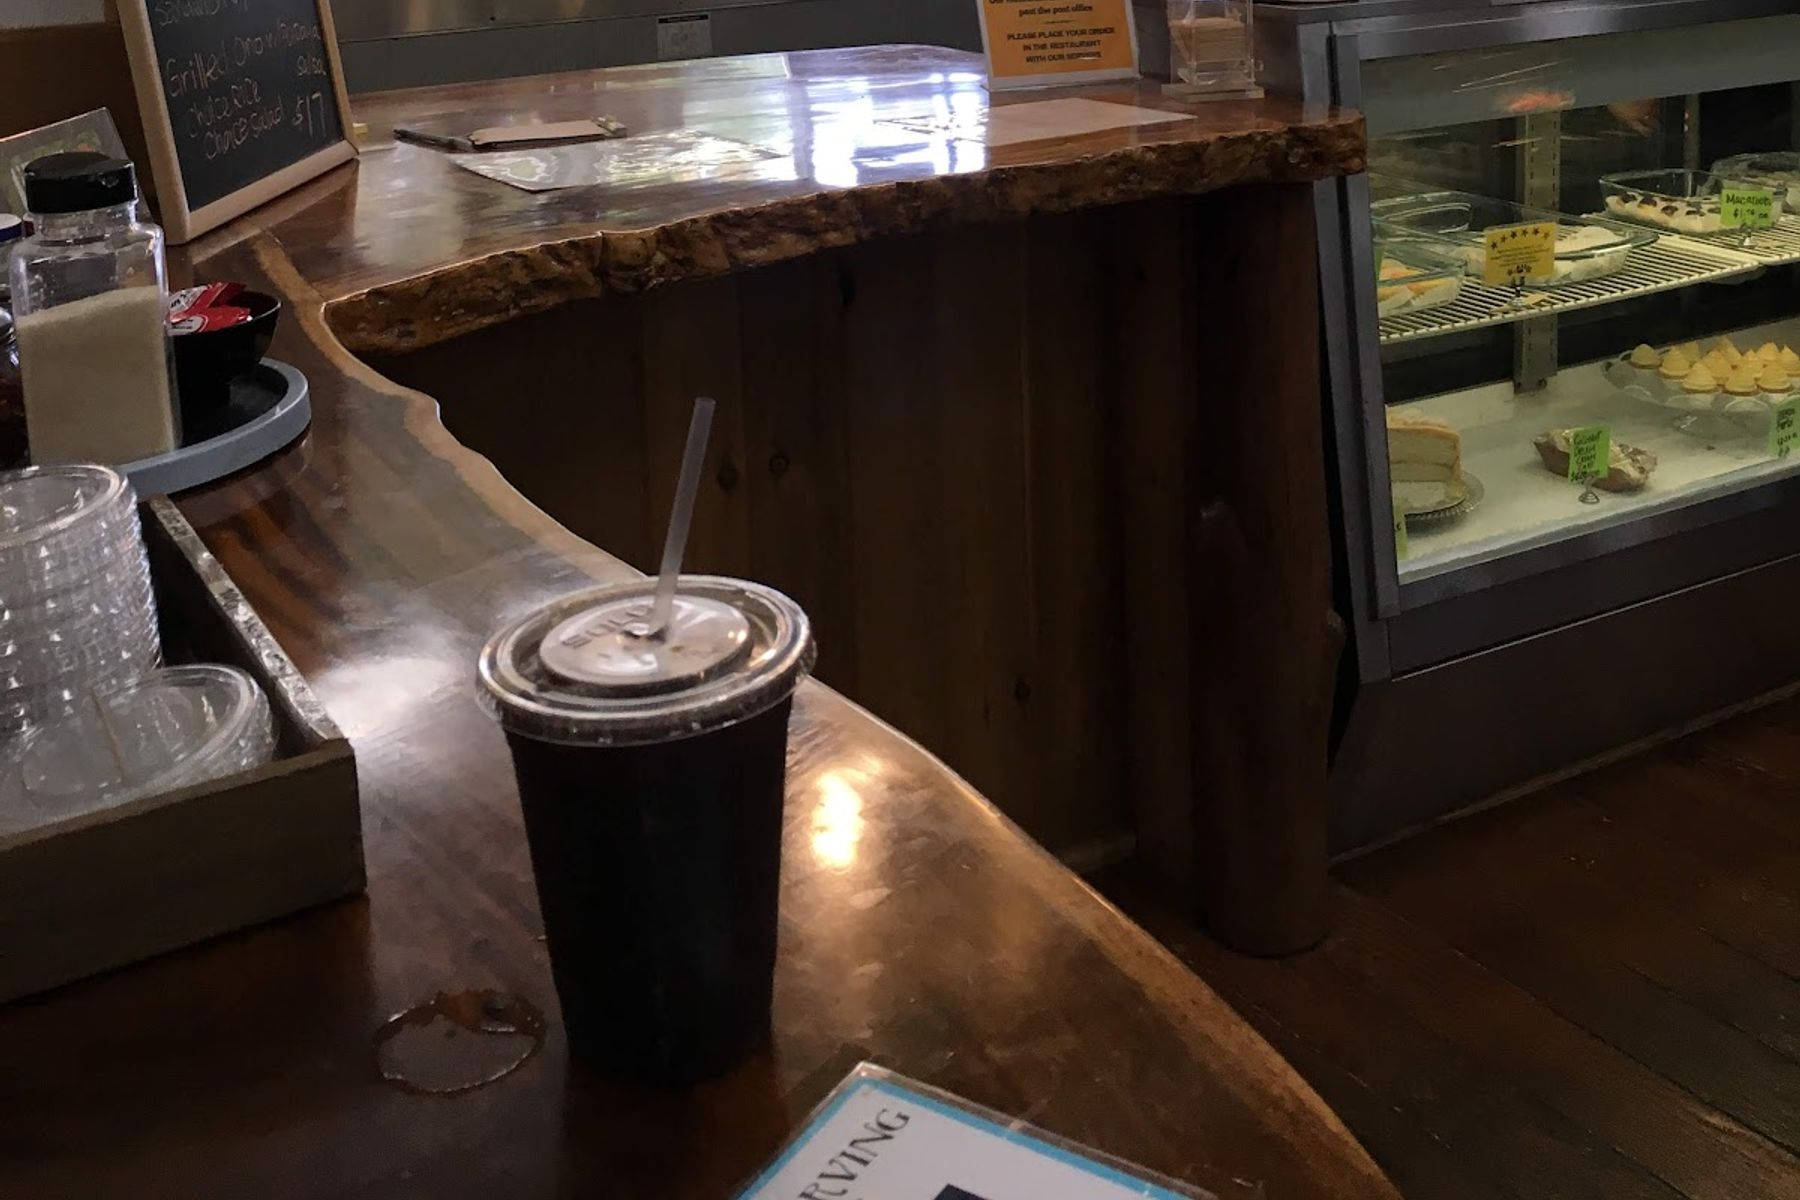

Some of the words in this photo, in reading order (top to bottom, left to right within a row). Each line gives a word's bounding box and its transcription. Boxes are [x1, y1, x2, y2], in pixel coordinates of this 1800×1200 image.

[1052, 5, 1070, 15] post
[1071, 3, 1093, 13] office
[1007, 31, 1037, 41] PLEASE
[1038, 30, 1064, 39] PLACE
